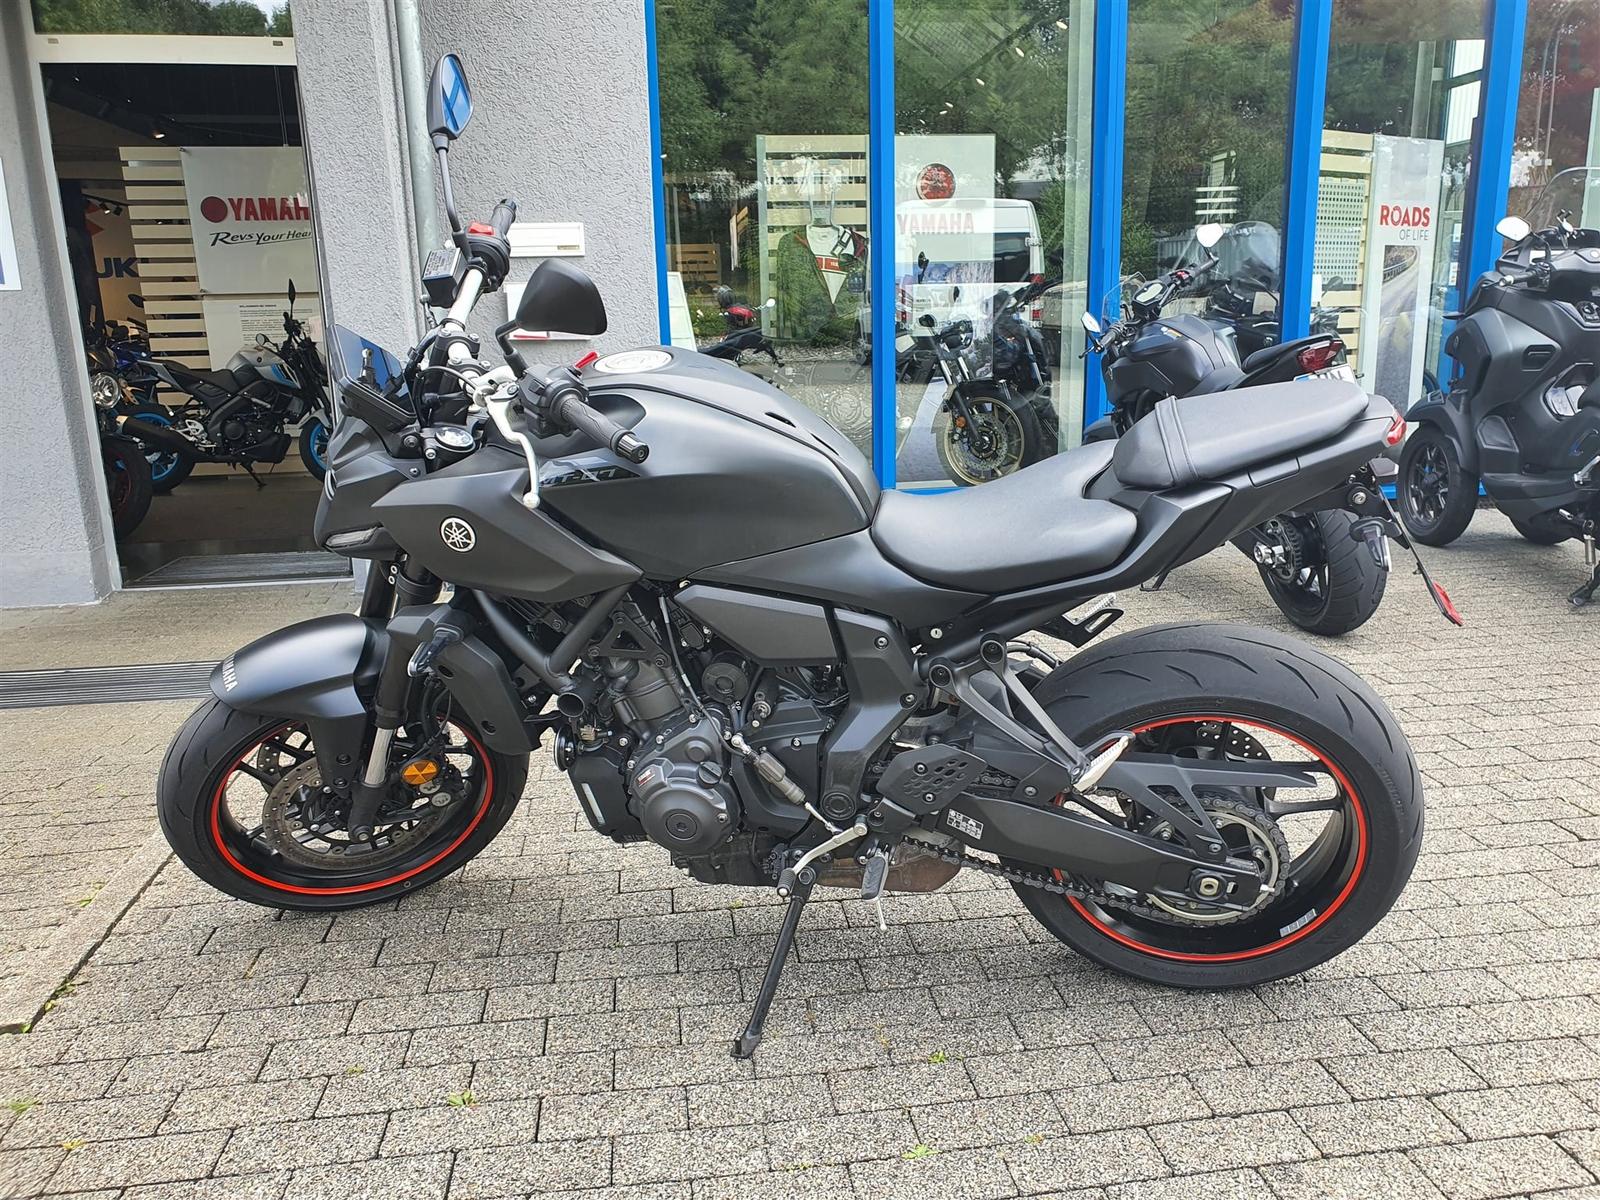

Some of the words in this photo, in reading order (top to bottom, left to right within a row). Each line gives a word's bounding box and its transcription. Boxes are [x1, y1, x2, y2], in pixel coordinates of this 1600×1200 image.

[227, 197, 310, 221] YAMAH
[1380, 205, 1430, 227] ROADS
[896, 213, 974, 235] YAMAHA
[1399, 229, 1411, 241] OF
[1412, 229, 1430, 241] LIFE
[209, 231, 255, 247] Revs
[256, 231, 286, 245] Your
[286, 230, 312, 240] Hear
